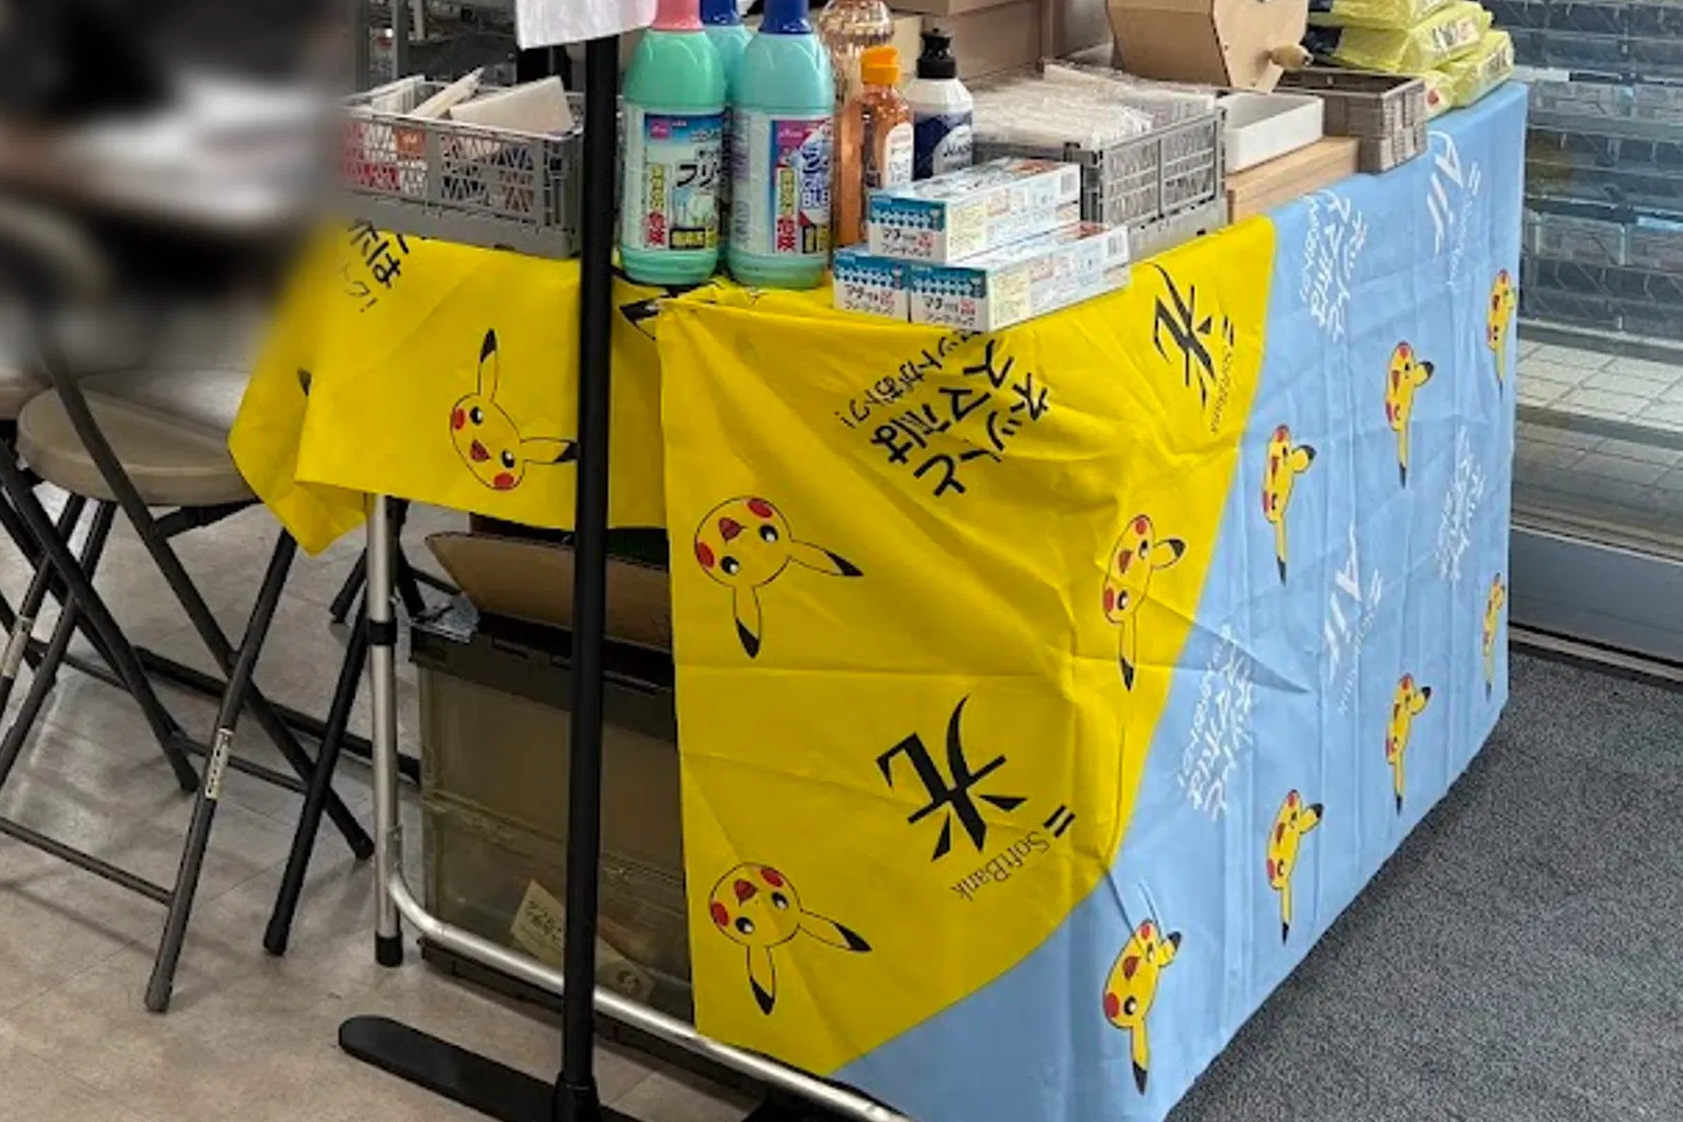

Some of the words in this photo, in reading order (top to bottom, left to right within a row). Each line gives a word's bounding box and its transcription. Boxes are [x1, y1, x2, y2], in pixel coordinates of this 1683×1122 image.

[870, 339, 1013, 464] スマホは
[913, 373, 1047, 497] ネットと
[874, 694, 1029, 862] 光
[949, 828, 1049, 904] SoftBank
